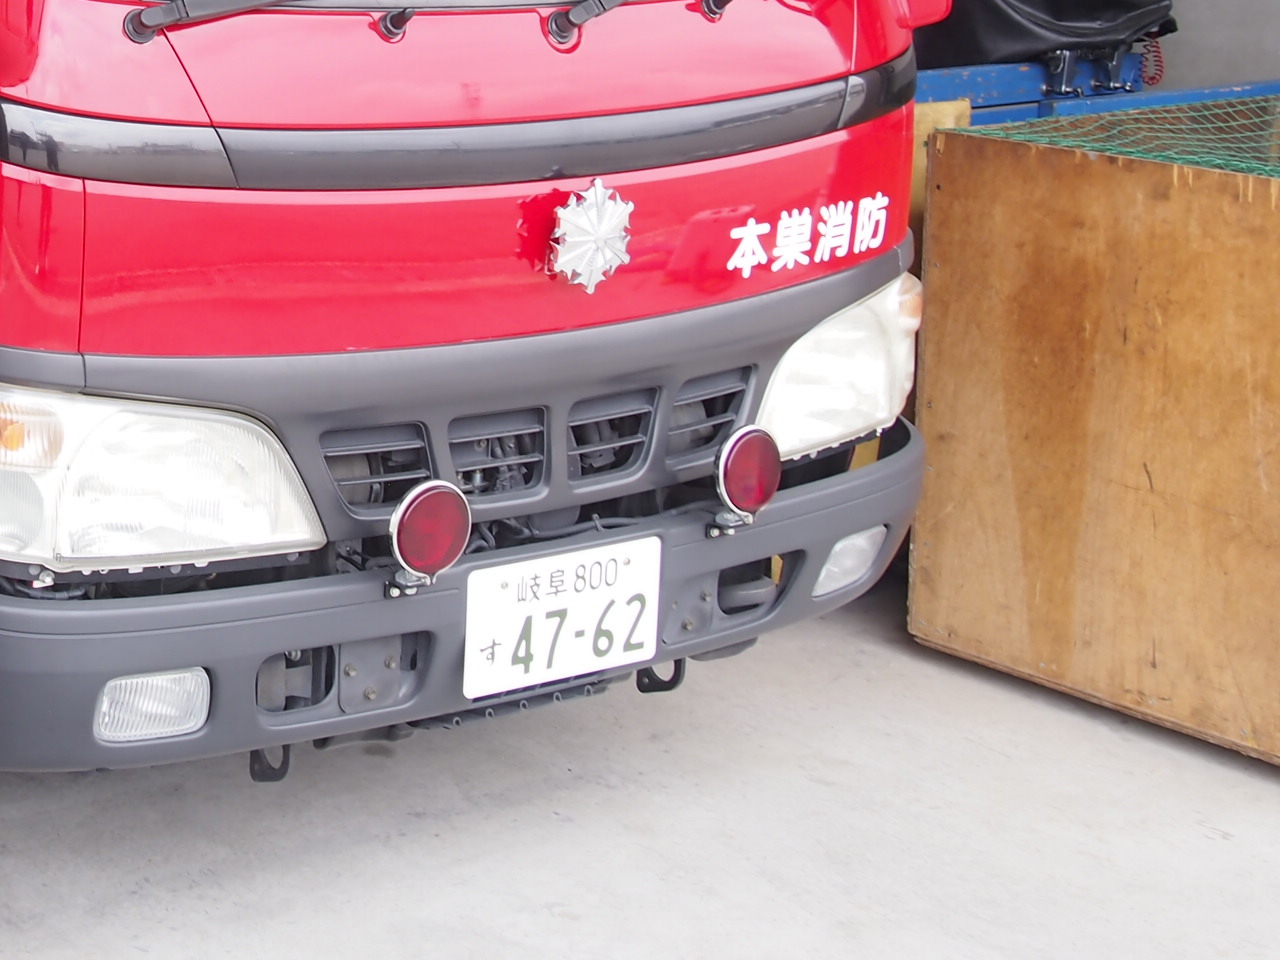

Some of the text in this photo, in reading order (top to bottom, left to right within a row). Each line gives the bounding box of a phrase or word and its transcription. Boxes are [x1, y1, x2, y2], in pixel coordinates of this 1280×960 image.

[726, 191, 889, 279] 本巣消防
[479, 593, 647, 674] す 47-62
